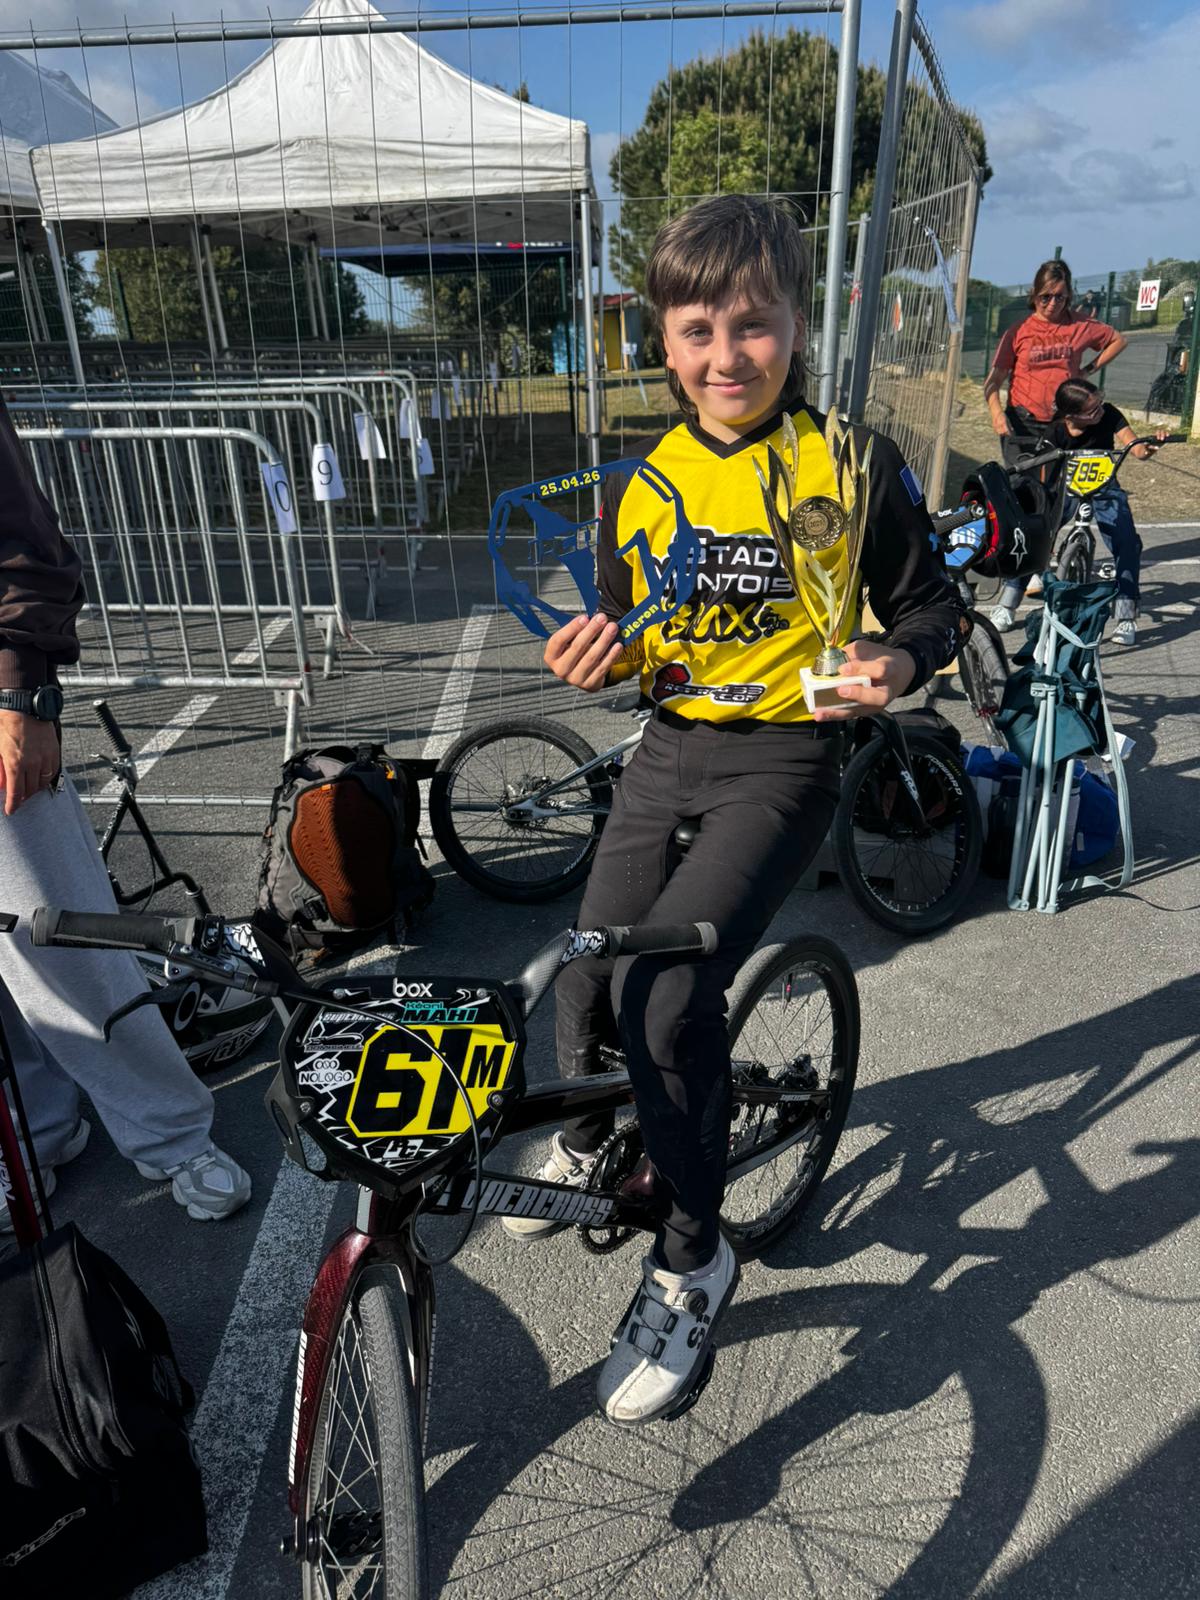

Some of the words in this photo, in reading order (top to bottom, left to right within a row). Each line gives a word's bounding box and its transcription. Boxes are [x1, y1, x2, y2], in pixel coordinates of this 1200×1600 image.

[1140, 285, 1157, 304] WC
[317, 459, 333, 486] 9
[540, 470, 600, 496] 25.04.26
[687, 537, 785, 568] STAD
[393, 977, 434, 998] box
[401, 1008, 478, 1023] MAHI
